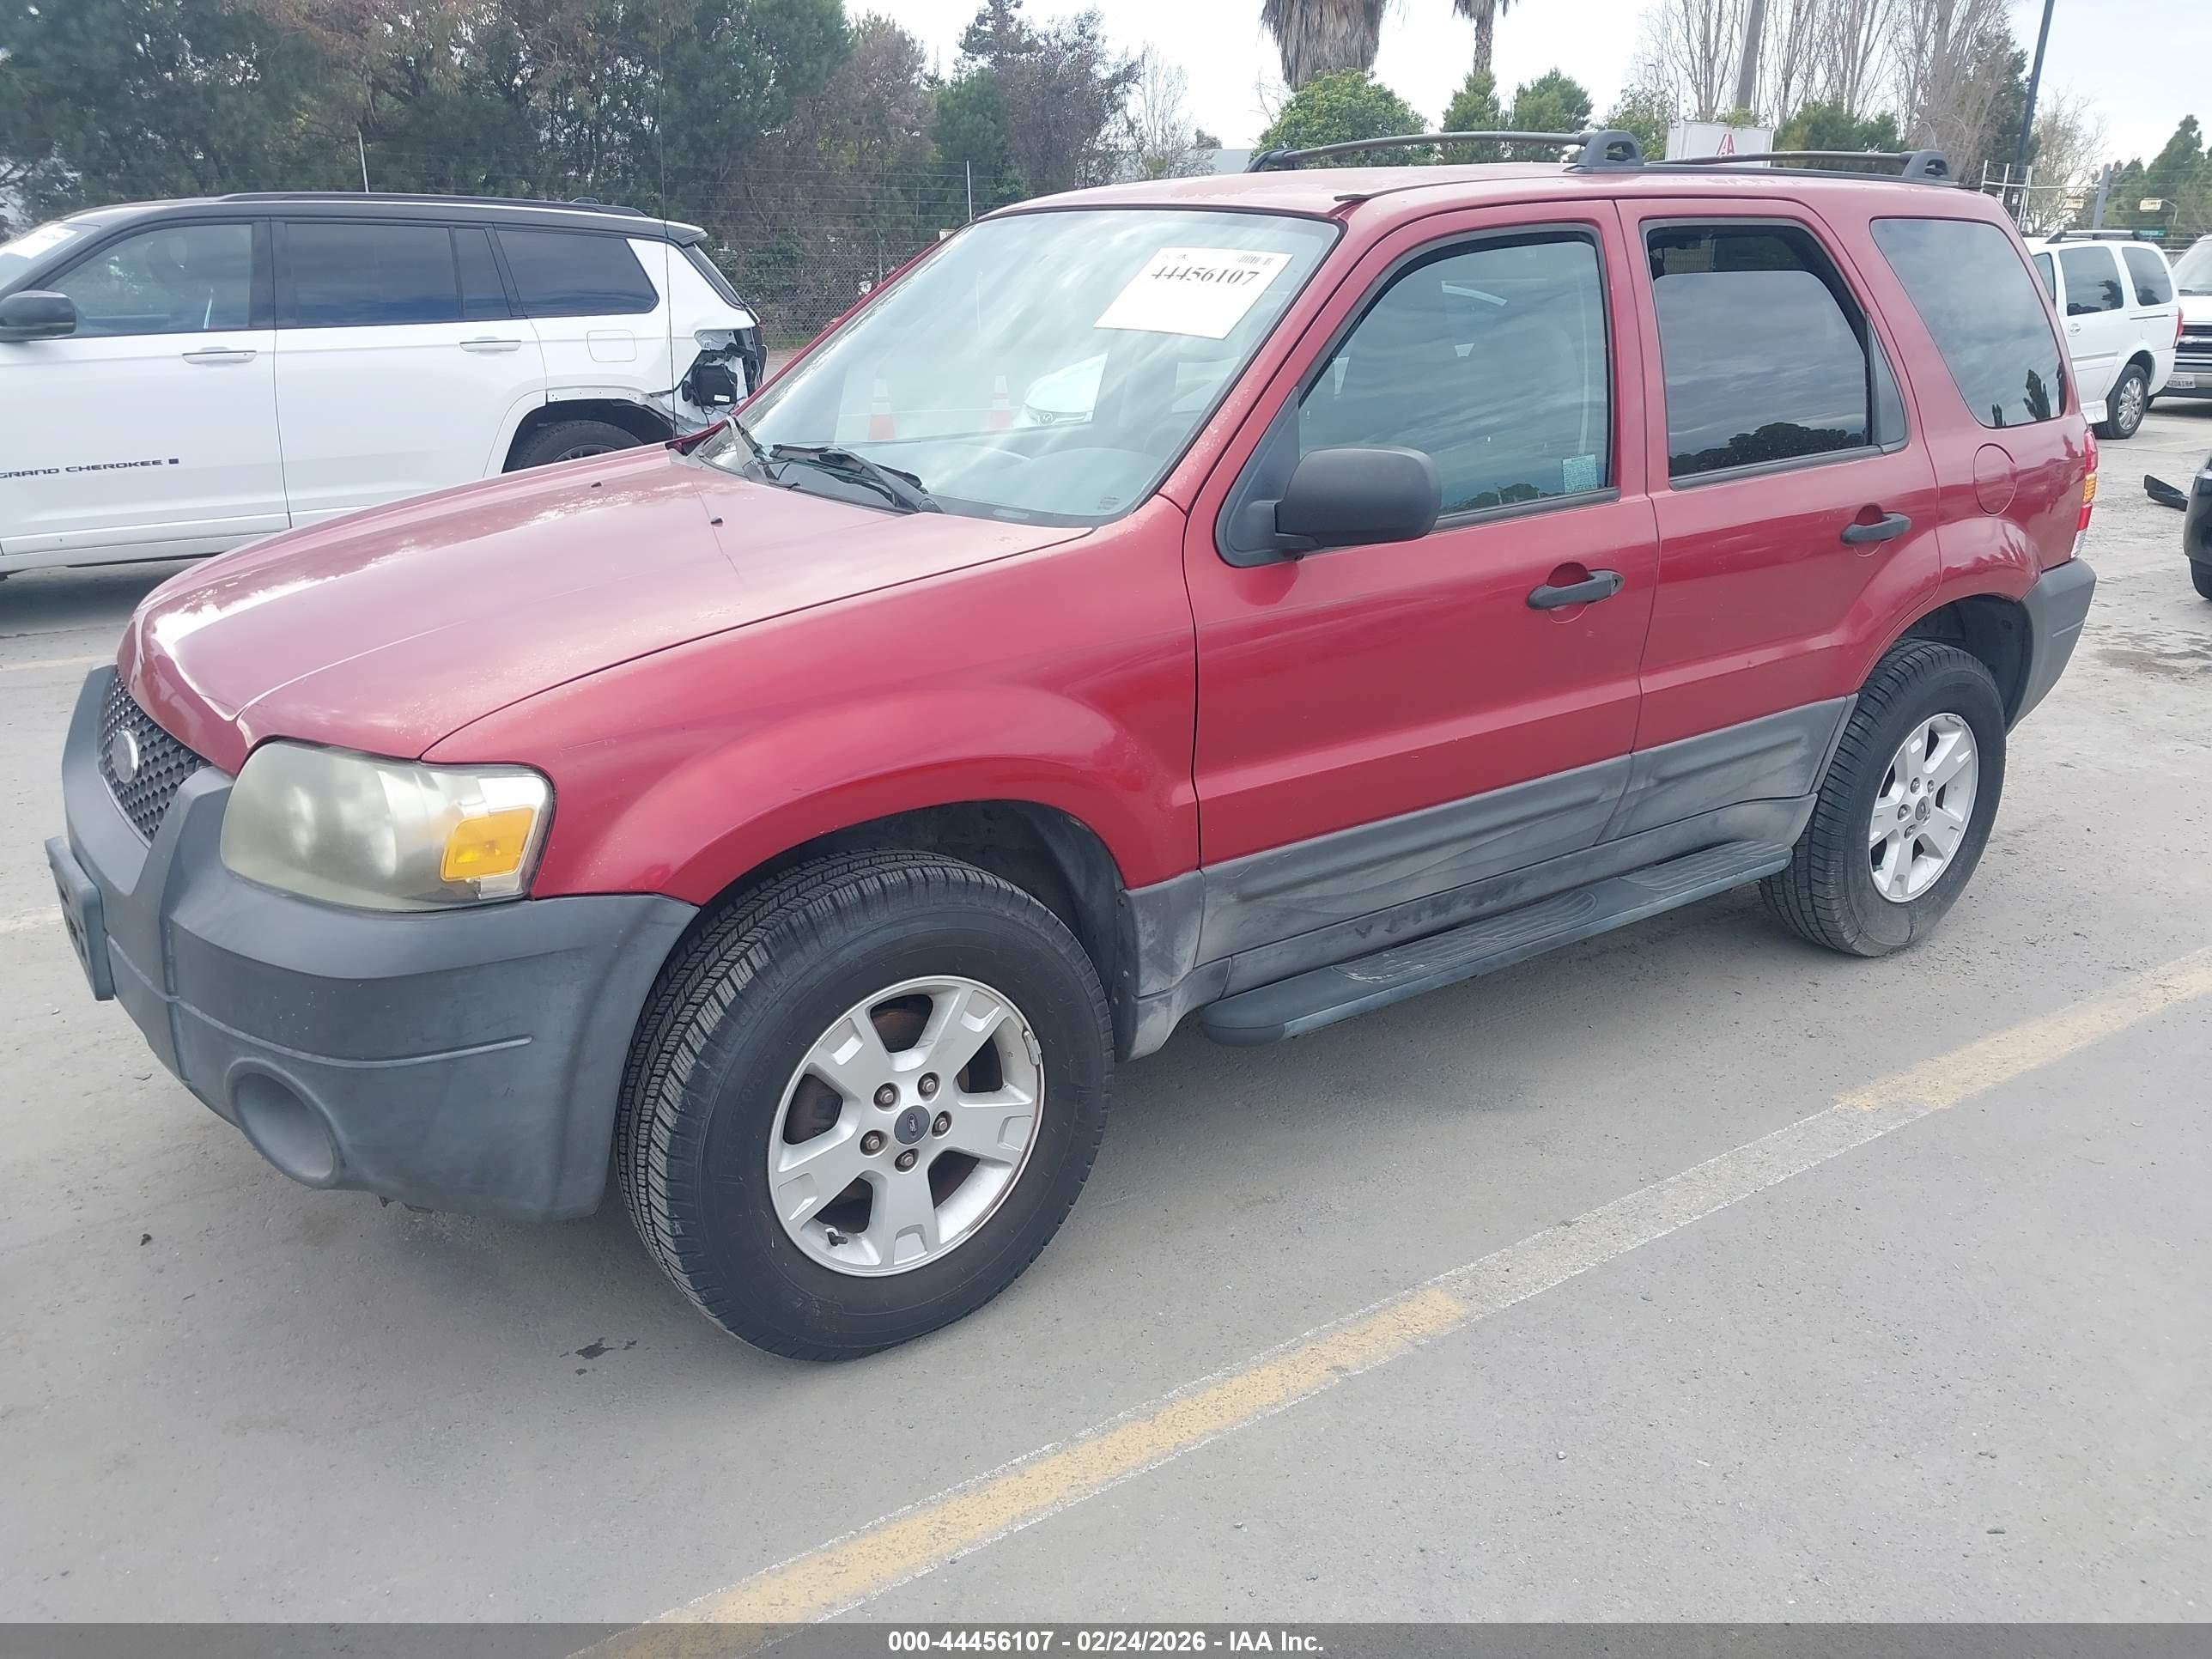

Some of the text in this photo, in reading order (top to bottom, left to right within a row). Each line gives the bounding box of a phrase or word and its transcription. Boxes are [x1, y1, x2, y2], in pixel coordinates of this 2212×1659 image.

[1151, 264, 1260, 286] 44456107
[0, 459, 163, 478] GRAND CHEROKEE
